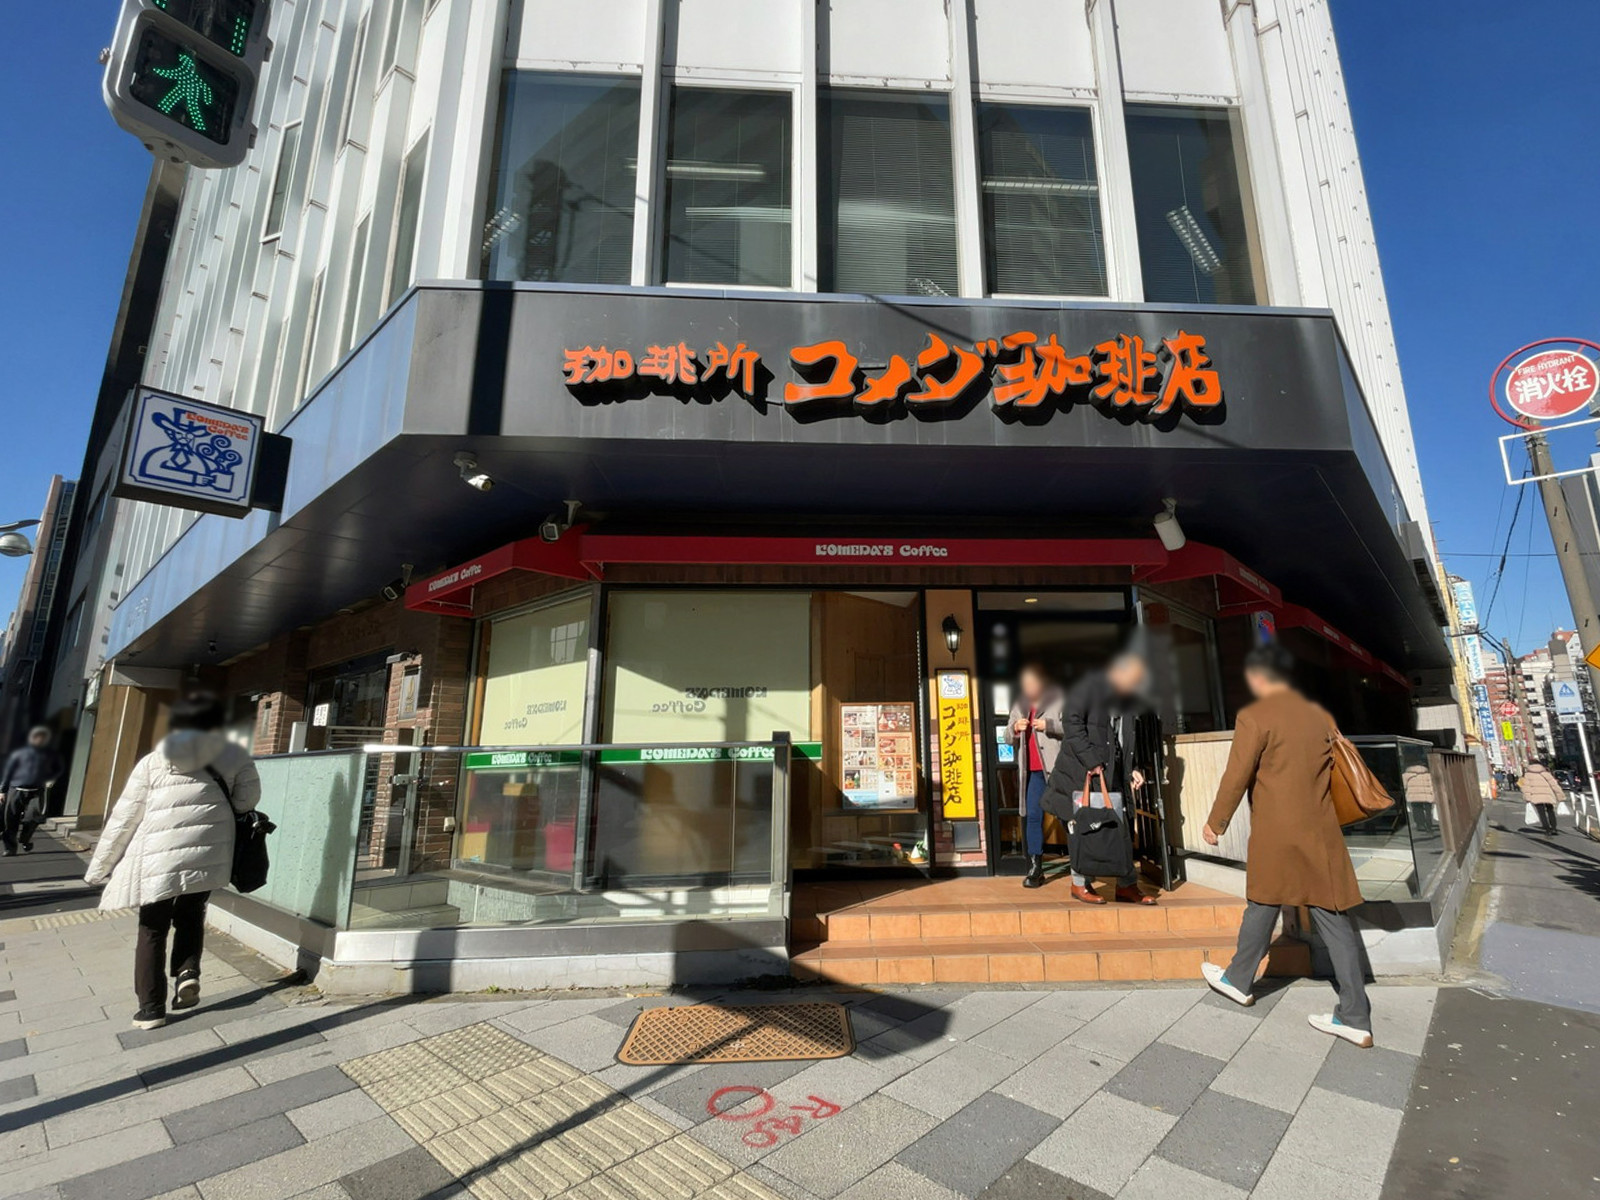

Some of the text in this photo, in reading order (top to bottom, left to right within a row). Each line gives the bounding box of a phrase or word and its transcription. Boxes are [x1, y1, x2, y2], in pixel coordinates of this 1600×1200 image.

[564, 341, 760, 396] 珈琲所
[1517, 355, 1576, 376] FIRE HYDRANT
[1513, 364, 1592, 405] 消火栓
[815, 543, 949, 557] KOMEDA'S Coffee
